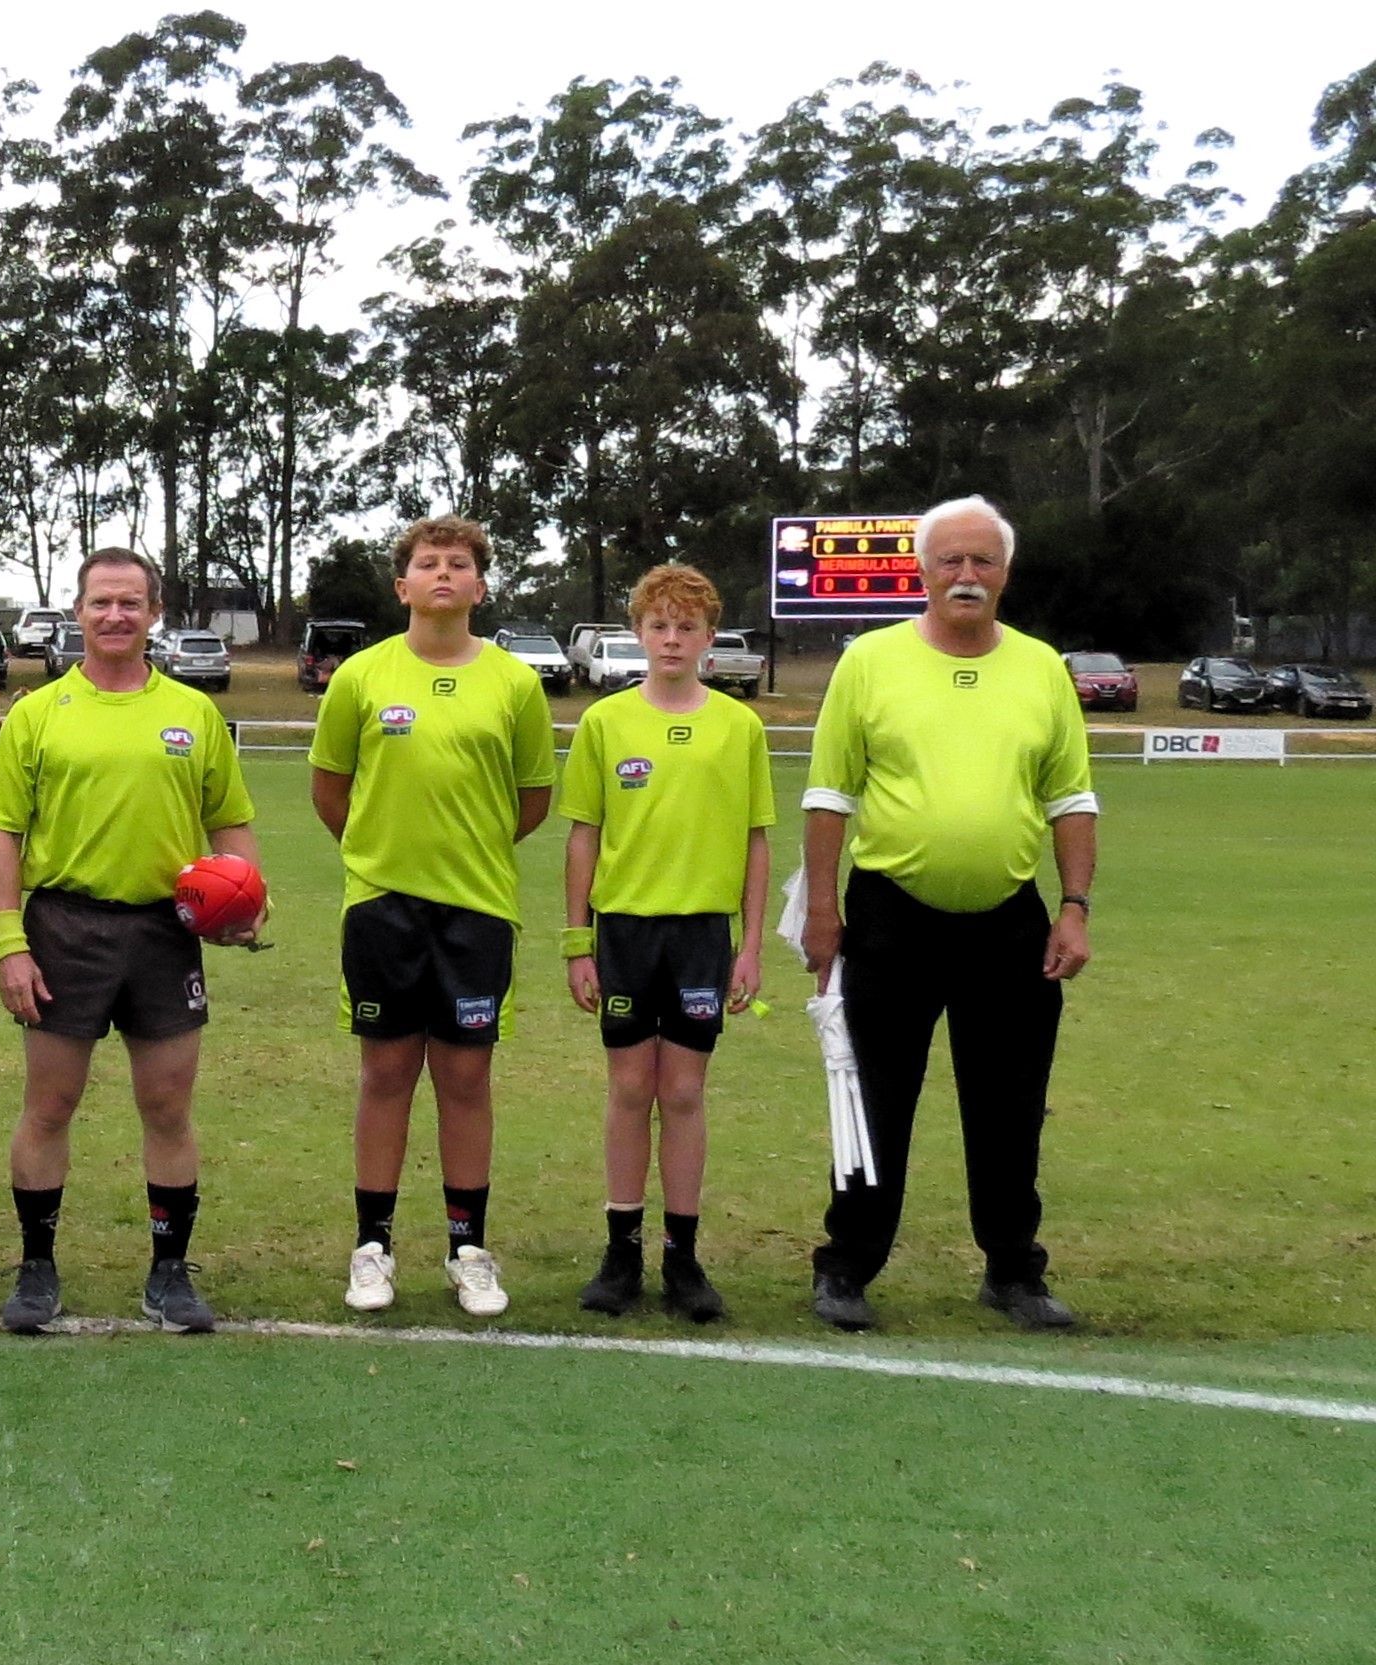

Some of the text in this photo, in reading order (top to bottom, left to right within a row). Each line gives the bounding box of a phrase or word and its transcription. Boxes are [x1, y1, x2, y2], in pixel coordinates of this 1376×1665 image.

[816, 520, 874, 533] PAMBULA
[824, 537, 909, 553] 0 0 0
[819, 558, 889, 571] MERIMBULA
[824, 577, 909, 591] 0 0 0
[382, 710, 414, 721] AFL
[164, 730, 192, 743] AFL
[1153, 735, 1199, 752] DBC
[620, 762, 651, 775] AFL
[462, 1013, 492, 1024] AFL
